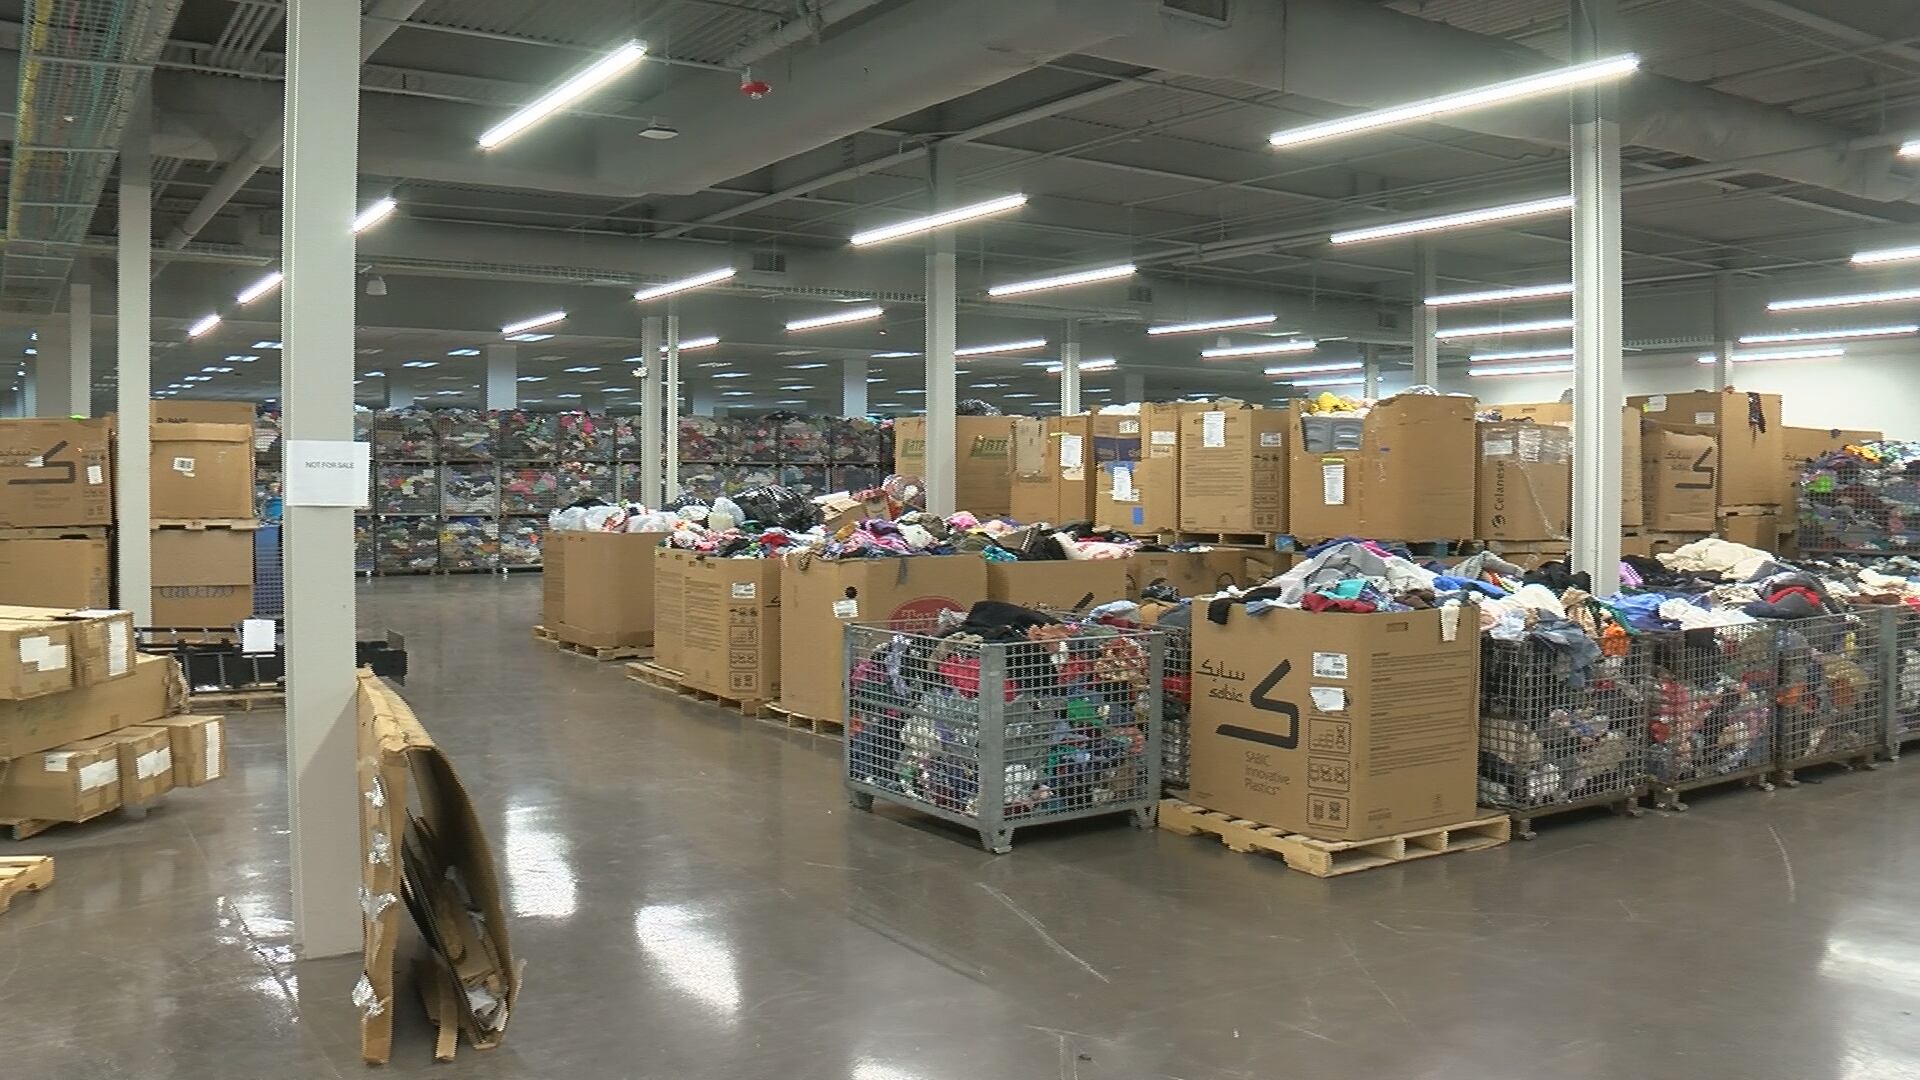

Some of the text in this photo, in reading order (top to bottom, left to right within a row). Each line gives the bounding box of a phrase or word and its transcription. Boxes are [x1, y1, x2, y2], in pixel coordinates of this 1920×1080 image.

[304, 461, 355, 470] NOT FOR SALE
[1494, 460, 1505, 511] Celanese
[1208, 684, 1245, 703] sabic
[1244, 749, 1271, 767] SABIC
[1244, 764, 1291, 786] Innovative
